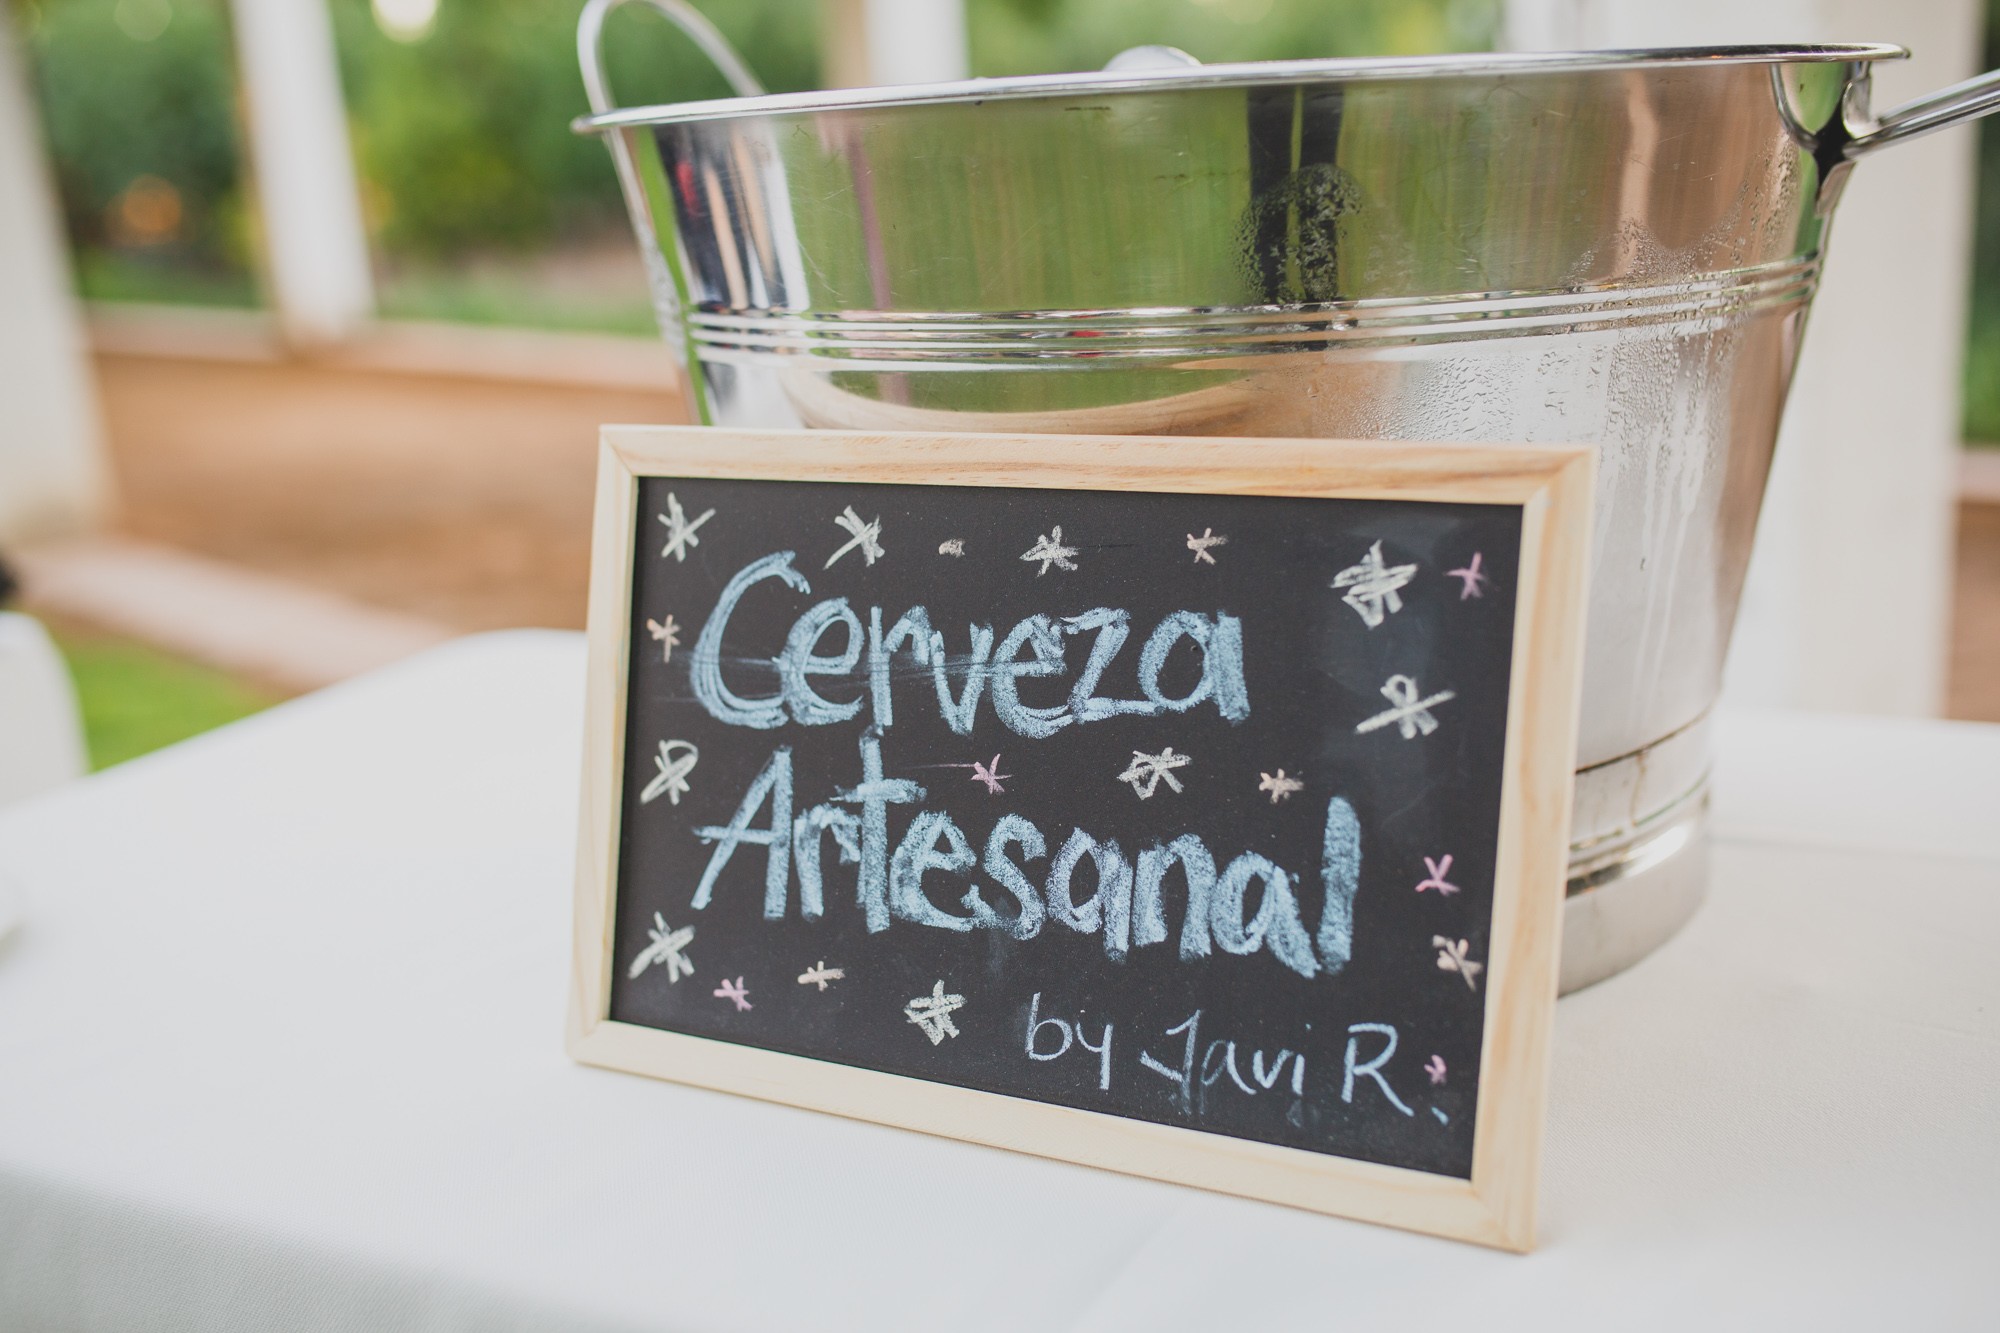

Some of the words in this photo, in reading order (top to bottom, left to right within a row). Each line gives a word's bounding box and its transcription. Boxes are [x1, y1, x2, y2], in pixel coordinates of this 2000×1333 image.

[690, 550, 1251, 739] Cerveza
[691, 729, 1362, 979] Artesanal
[1024, 991, 1114, 1090] by
[1139, 1009, 1311, 1114] Javi
[1341, 1022, 1449, 1126] R.
